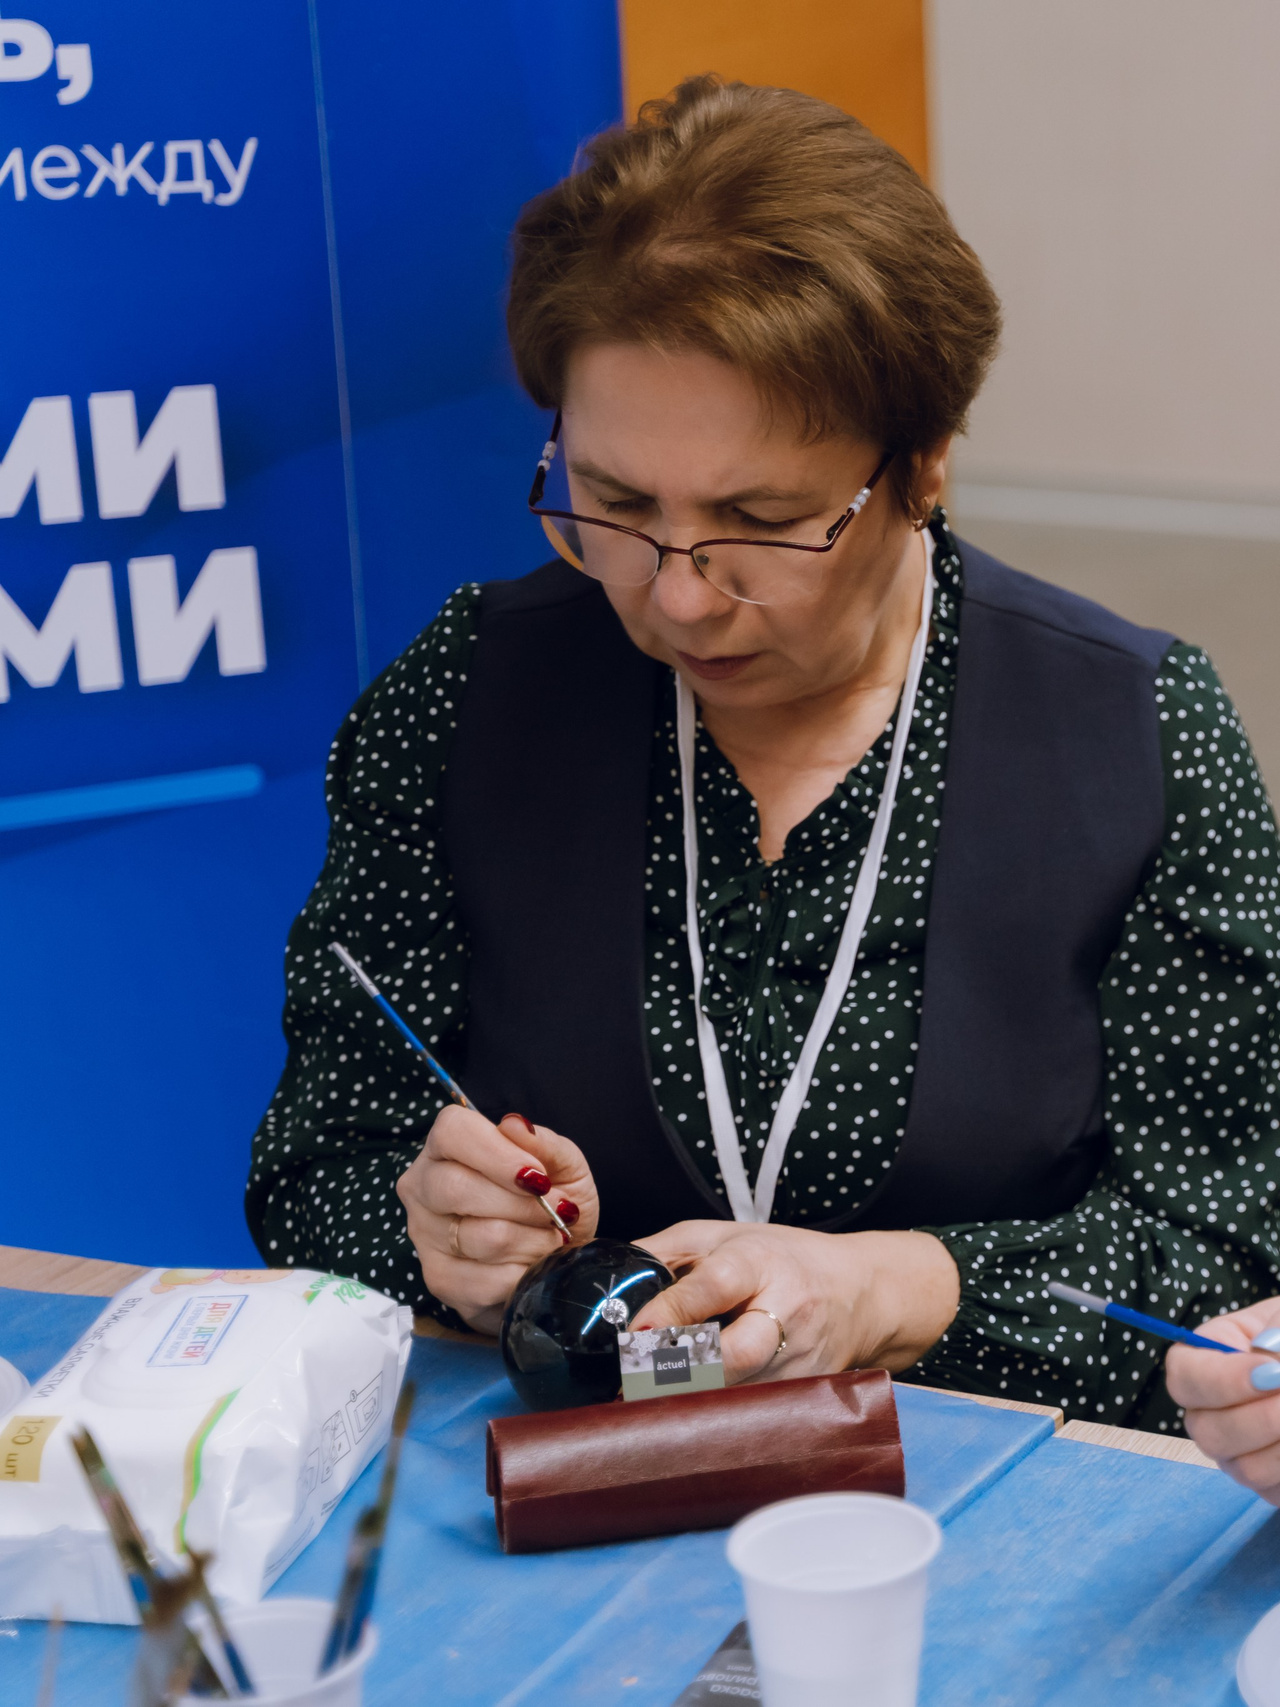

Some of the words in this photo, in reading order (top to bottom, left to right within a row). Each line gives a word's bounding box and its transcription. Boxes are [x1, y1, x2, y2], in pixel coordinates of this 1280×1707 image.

[203, 1302, 232, 1323] ДЛЯ
[180, 1326, 217, 1359] ДЕТЕЙ
[32, 1342, 95, 1399] САЛФЕТКИ
[12, 1418, 46, 1446] 120
